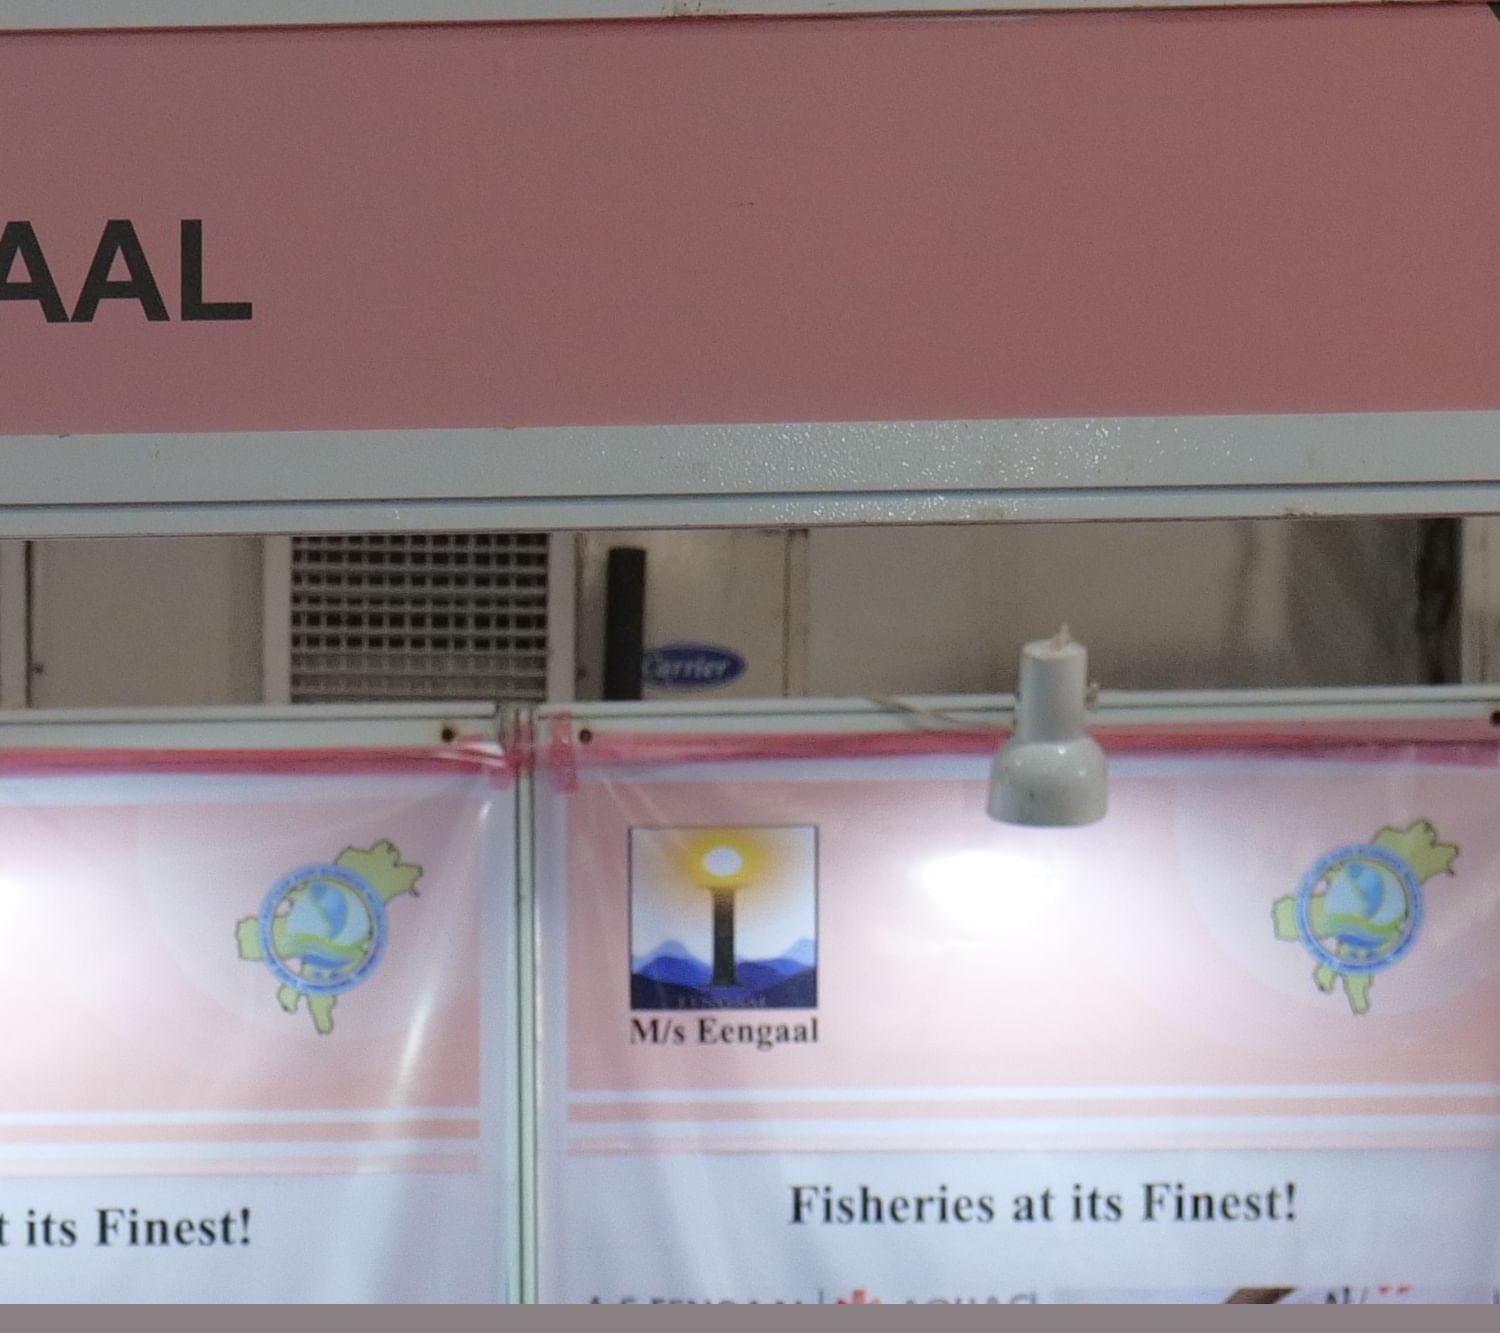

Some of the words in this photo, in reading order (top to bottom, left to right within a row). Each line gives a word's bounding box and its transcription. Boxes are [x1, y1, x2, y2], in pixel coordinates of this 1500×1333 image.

[631, 1017, 685, 1044] M/s
[698, 1015, 819, 1050] Eengaal
[789, 1185, 997, 1224] Fisheries
[1013, 1190, 1057, 1223] at
[1071, 1183, 1123, 1222] its
[1141, 1181, 1298, 1222] Finest!
[26, 1209, 78, 1247] its
[94, 1207, 252, 1247] Finest!
